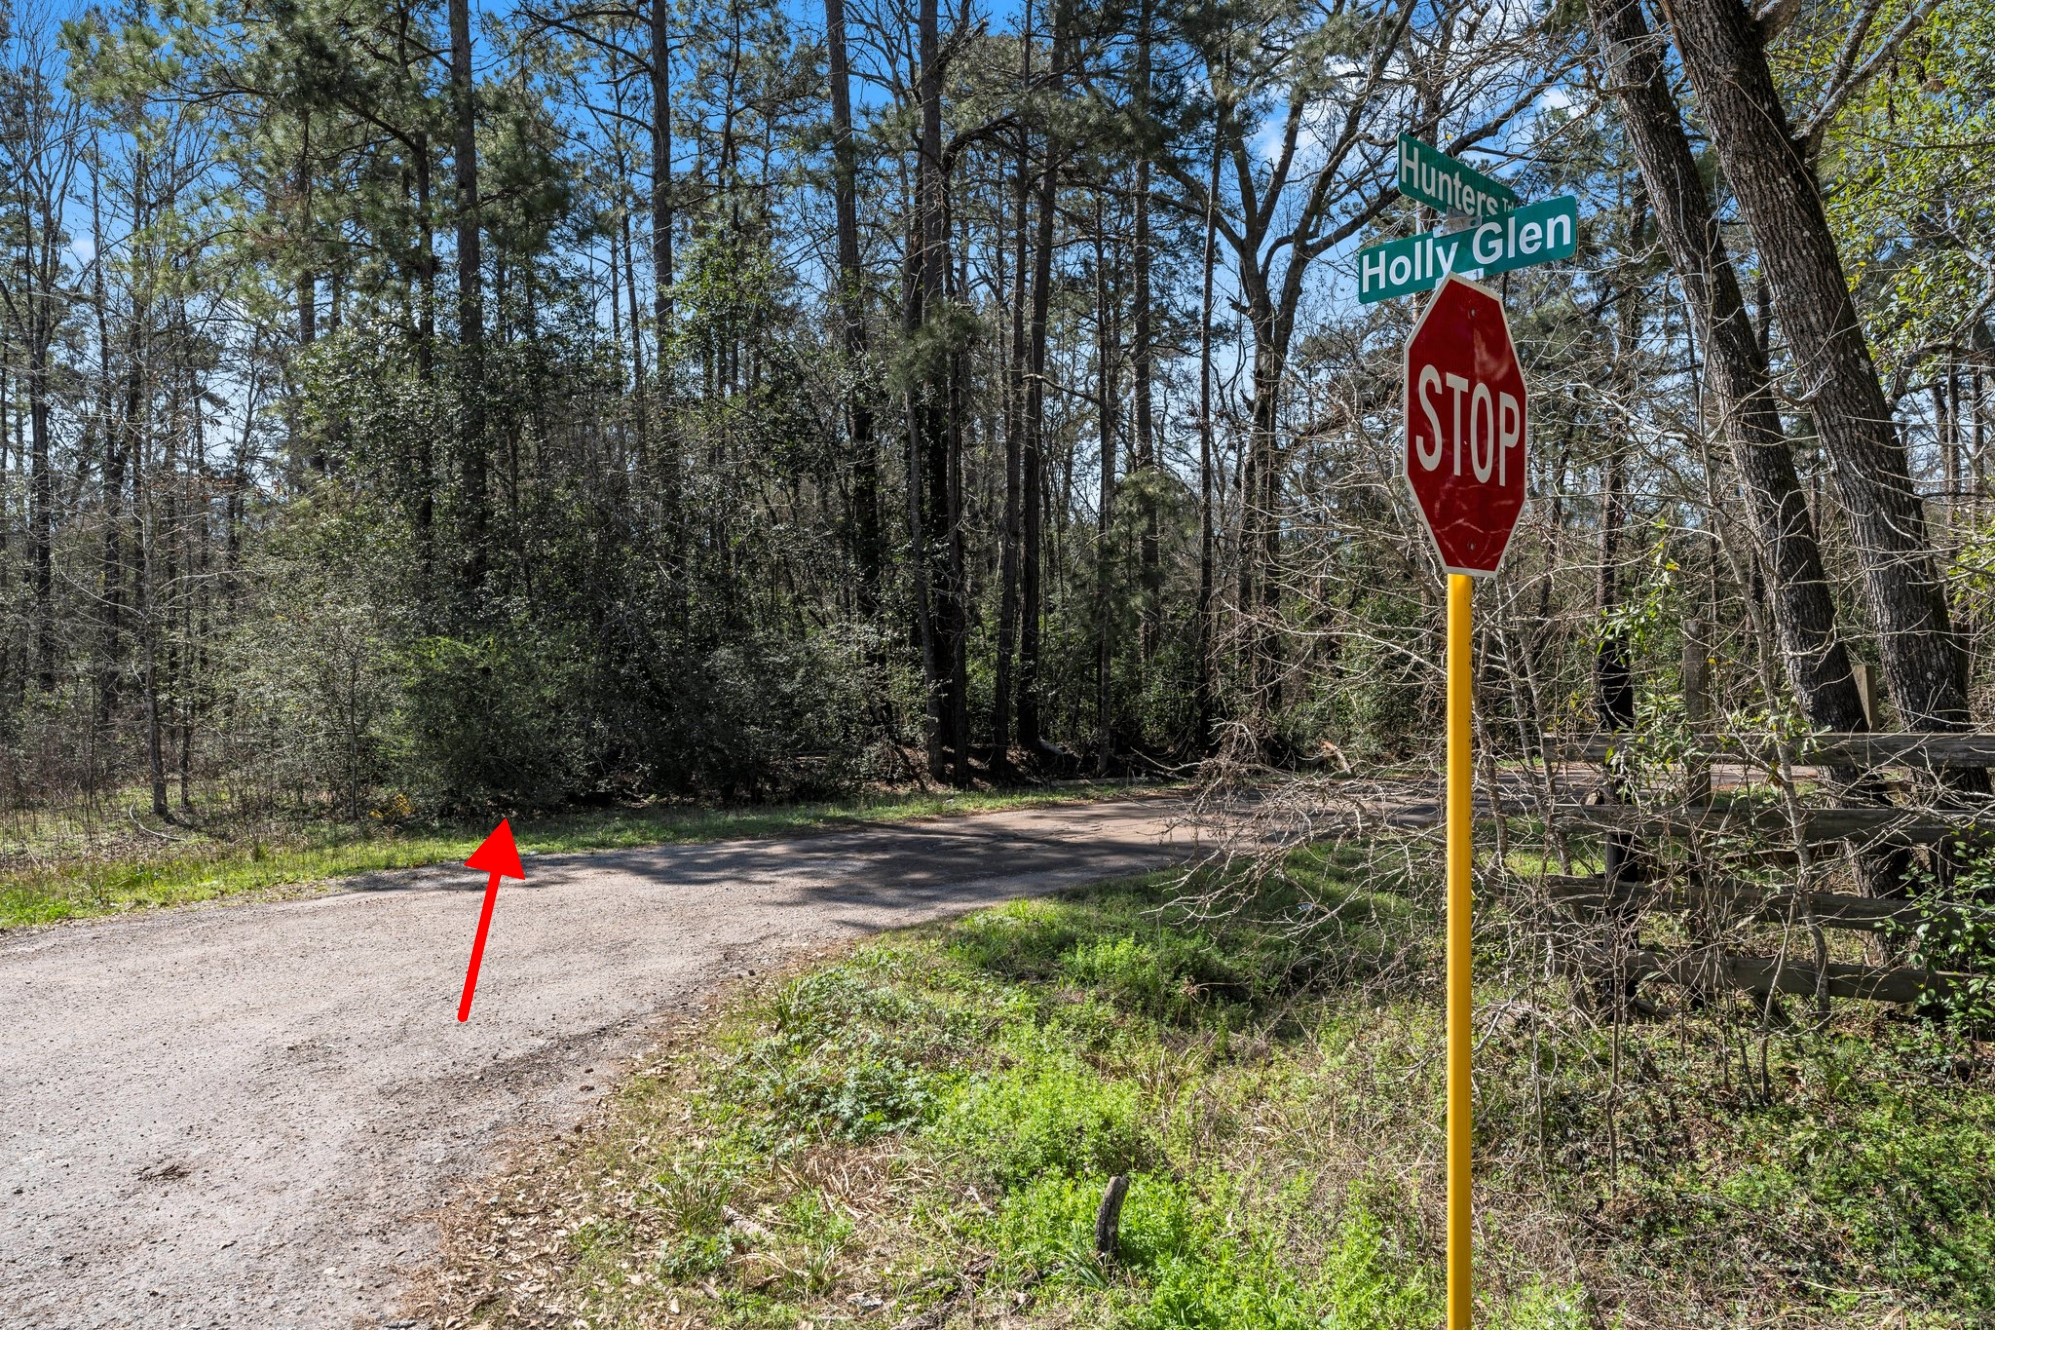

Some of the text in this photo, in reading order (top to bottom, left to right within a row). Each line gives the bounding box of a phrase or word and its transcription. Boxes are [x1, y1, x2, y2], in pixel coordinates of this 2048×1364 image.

[1401, 140, 1498, 216] Hunters
[1362, 213, 1571, 293] Holly Glen
[1415, 364, 1520, 487] STOP
